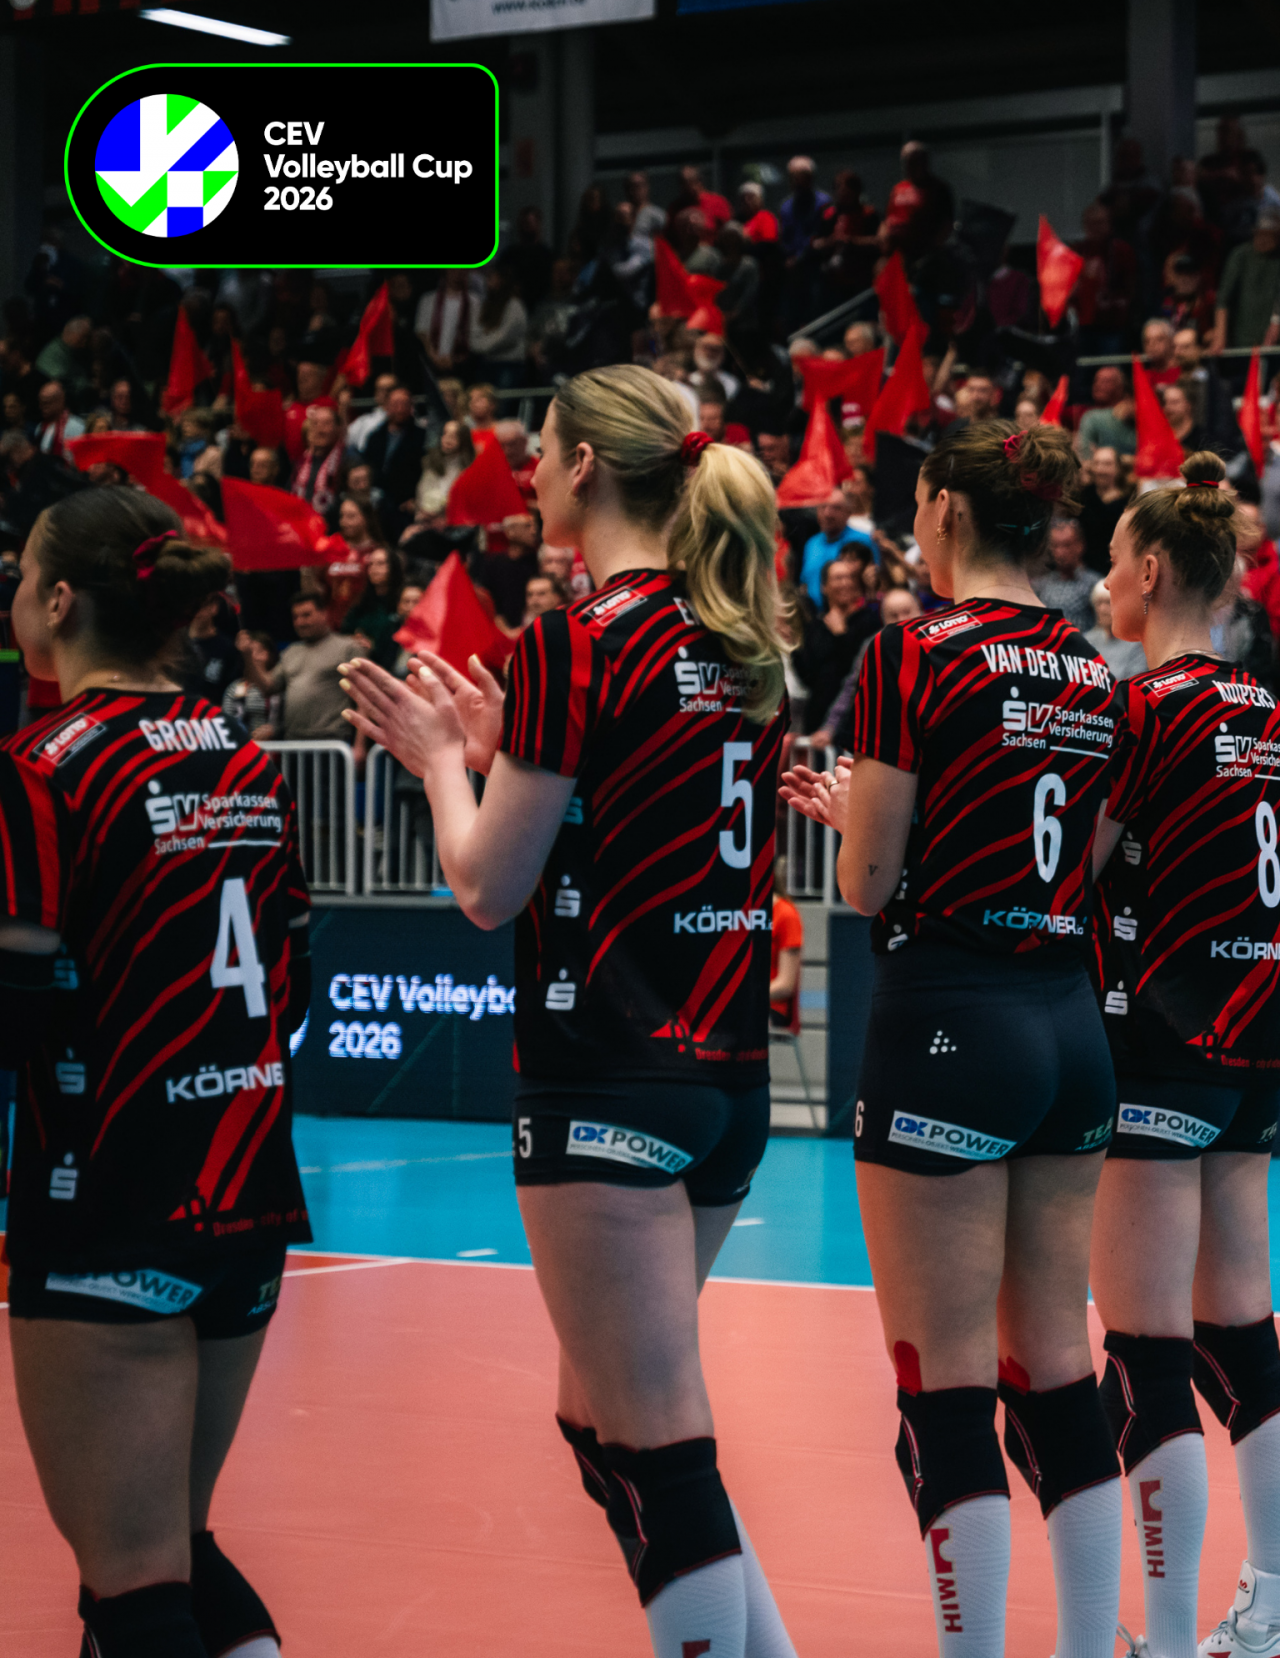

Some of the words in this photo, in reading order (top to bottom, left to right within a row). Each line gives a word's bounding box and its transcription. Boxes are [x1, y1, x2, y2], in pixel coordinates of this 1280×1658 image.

[938, 615, 968, 630] LOTTO
[980, 643, 1023, 675] VAN
[1025, 646, 1061, 681] DER
[1061, 652, 1112, 693] WERFF
[679, 697, 723, 713] Sachsen
[1211, 679, 1276, 710] KUIPERS
[1054, 704, 1114, 729] Sparkassen
[139, 717, 237, 752] GROME
[1002, 733, 1047, 750] Sachsen
[1048, 721, 1113, 748] Versicherung
[1216, 765, 1253, 778] Sachsen
[202, 791, 278, 812] Sparkassen
[718, 742, 753, 869] 5
[199, 812, 282, 833] Versicherung
[1033, 773, 1066, 883] 6
[154, 836, 205, 856] Sachsen
[210, 877, 267, 1018] 4
[329, 973, 394, 1012] CEV
[328, 1020, 403, 1059] 2026
[855, 1100, 865, 1138] 6
[1154, 1112, 1216, 1143] POWER
[518, 1117, 533, 1159] 5
[610, 1130, 687, 1171] POWER
[929, 1124, 1010, 1156] POWER
[94, 1270, 194, 1306] OWER
